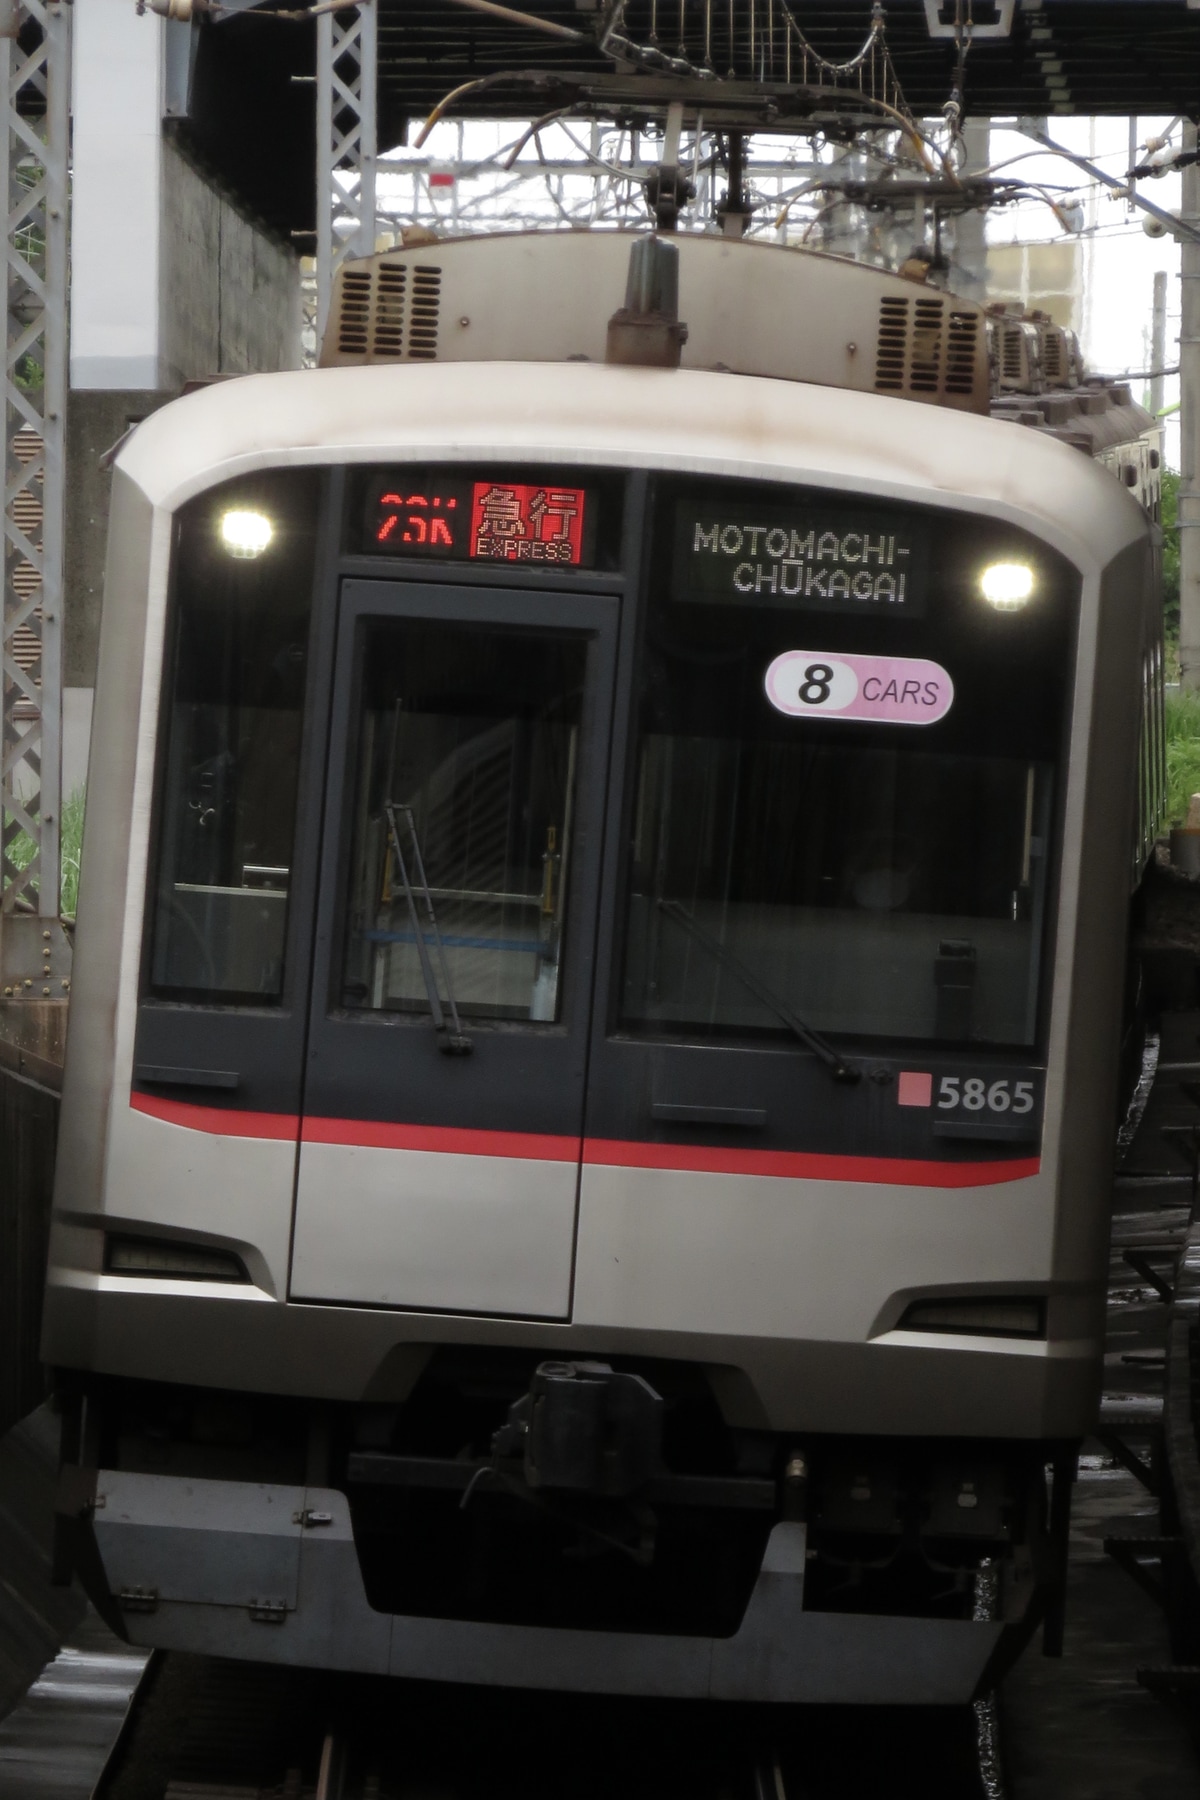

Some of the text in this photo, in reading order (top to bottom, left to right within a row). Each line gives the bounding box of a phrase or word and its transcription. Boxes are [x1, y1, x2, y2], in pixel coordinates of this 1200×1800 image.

[477, 487, 577, 540] 急行
[476, 537, 572, 561] EXPRESS
[693, 522, 911, 565] MOTOMACHI-
[733, 559, 906, 602] CHŪKAGAI
[798, 663, 940, 706] 8 CARS
[937, 1076, 1035, 1114] 5865
